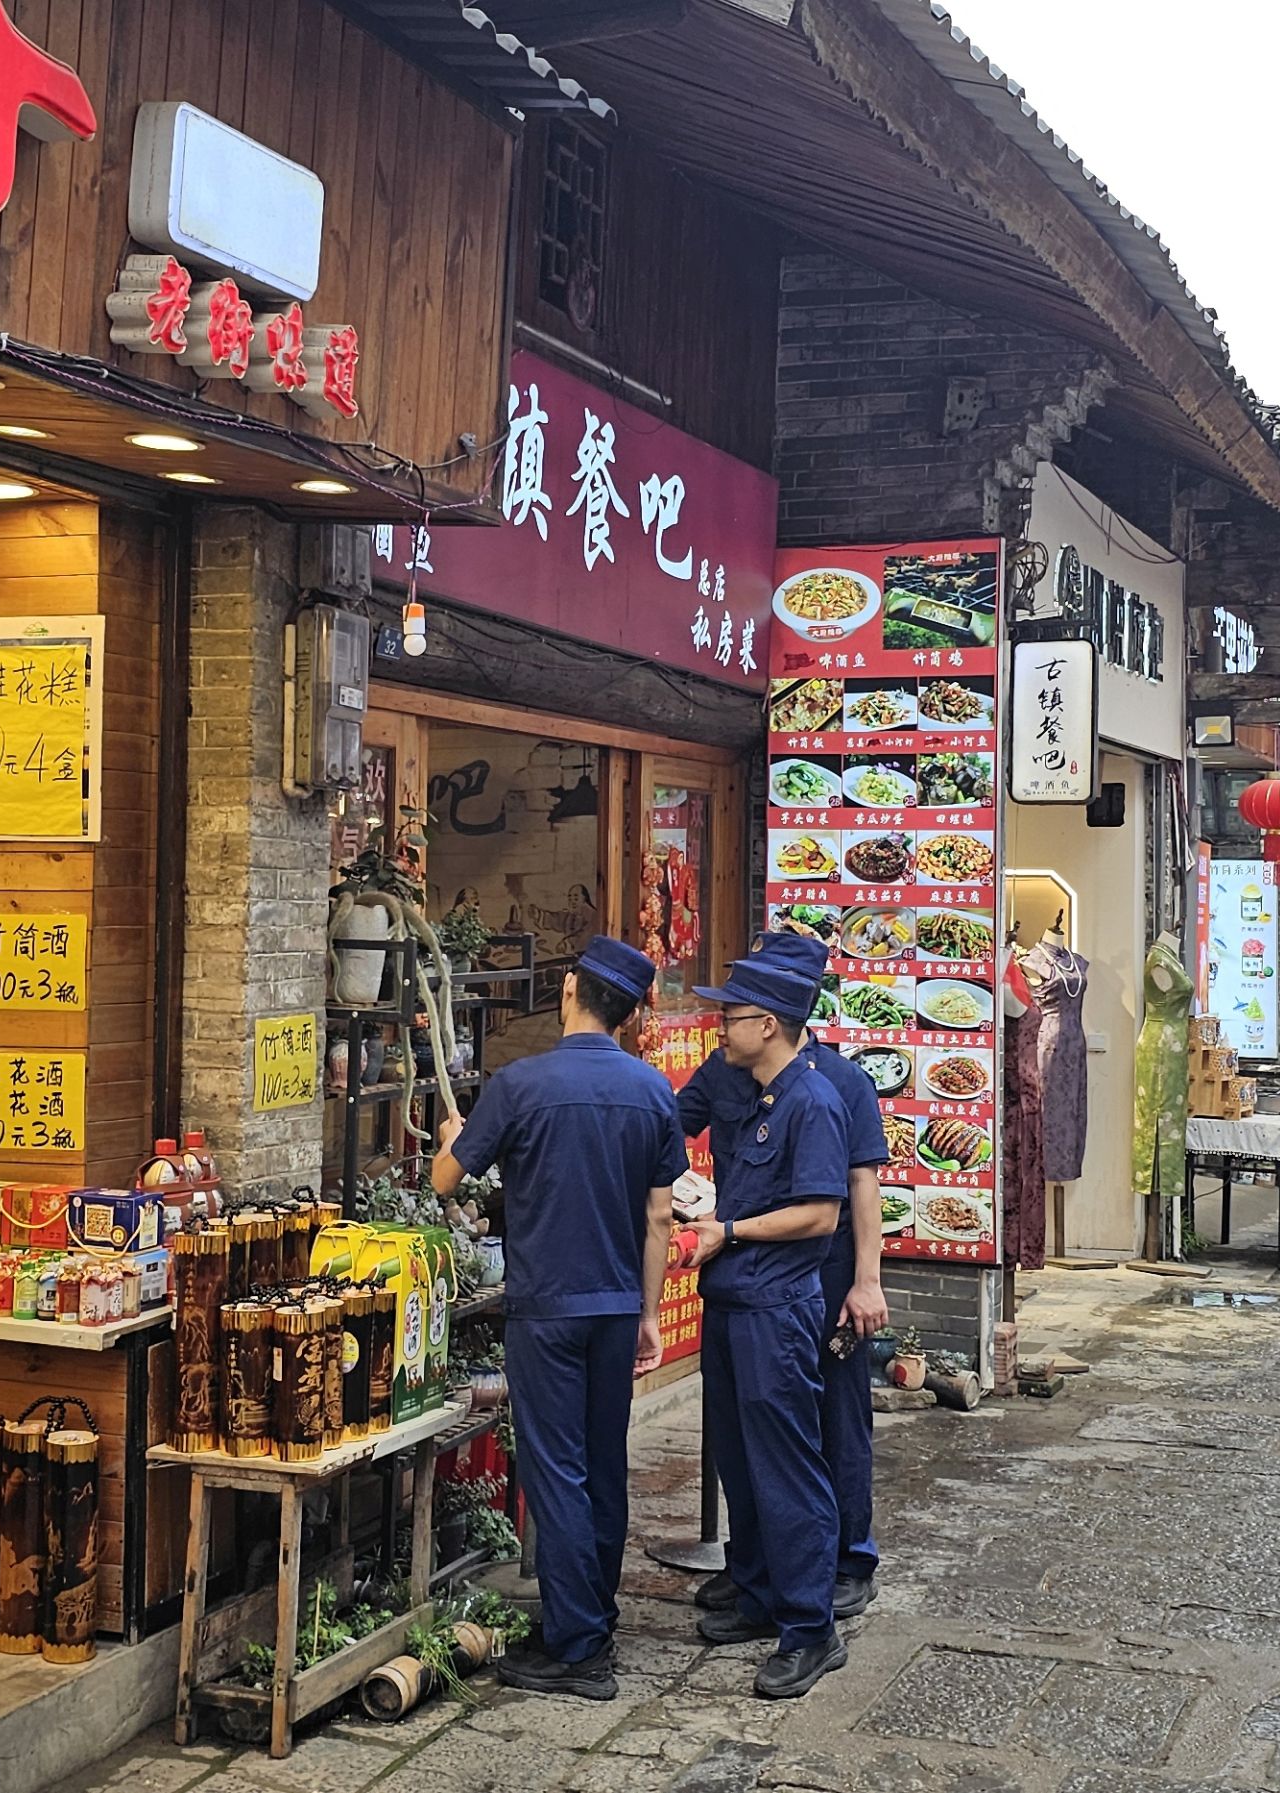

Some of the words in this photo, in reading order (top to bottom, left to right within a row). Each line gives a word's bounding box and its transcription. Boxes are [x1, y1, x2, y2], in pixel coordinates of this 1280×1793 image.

[384, 641, 396, 655] 32
[690, 606, 757, 675] 私房菜
[818, 652, 867, 669] 啤酒鱼
[912, 650, 964, 668] 竹筒鸡
[1032, 657, 1068, 771] 古镇餐吧
[787, 737, 825, 749] 竹筒饭
[854, 813, 905, 825] 苦瓜炒蛋
[930, 890, 980, 904] 麻婆豆腐
[261, 1022, 312, 1062] 竹筒酒
